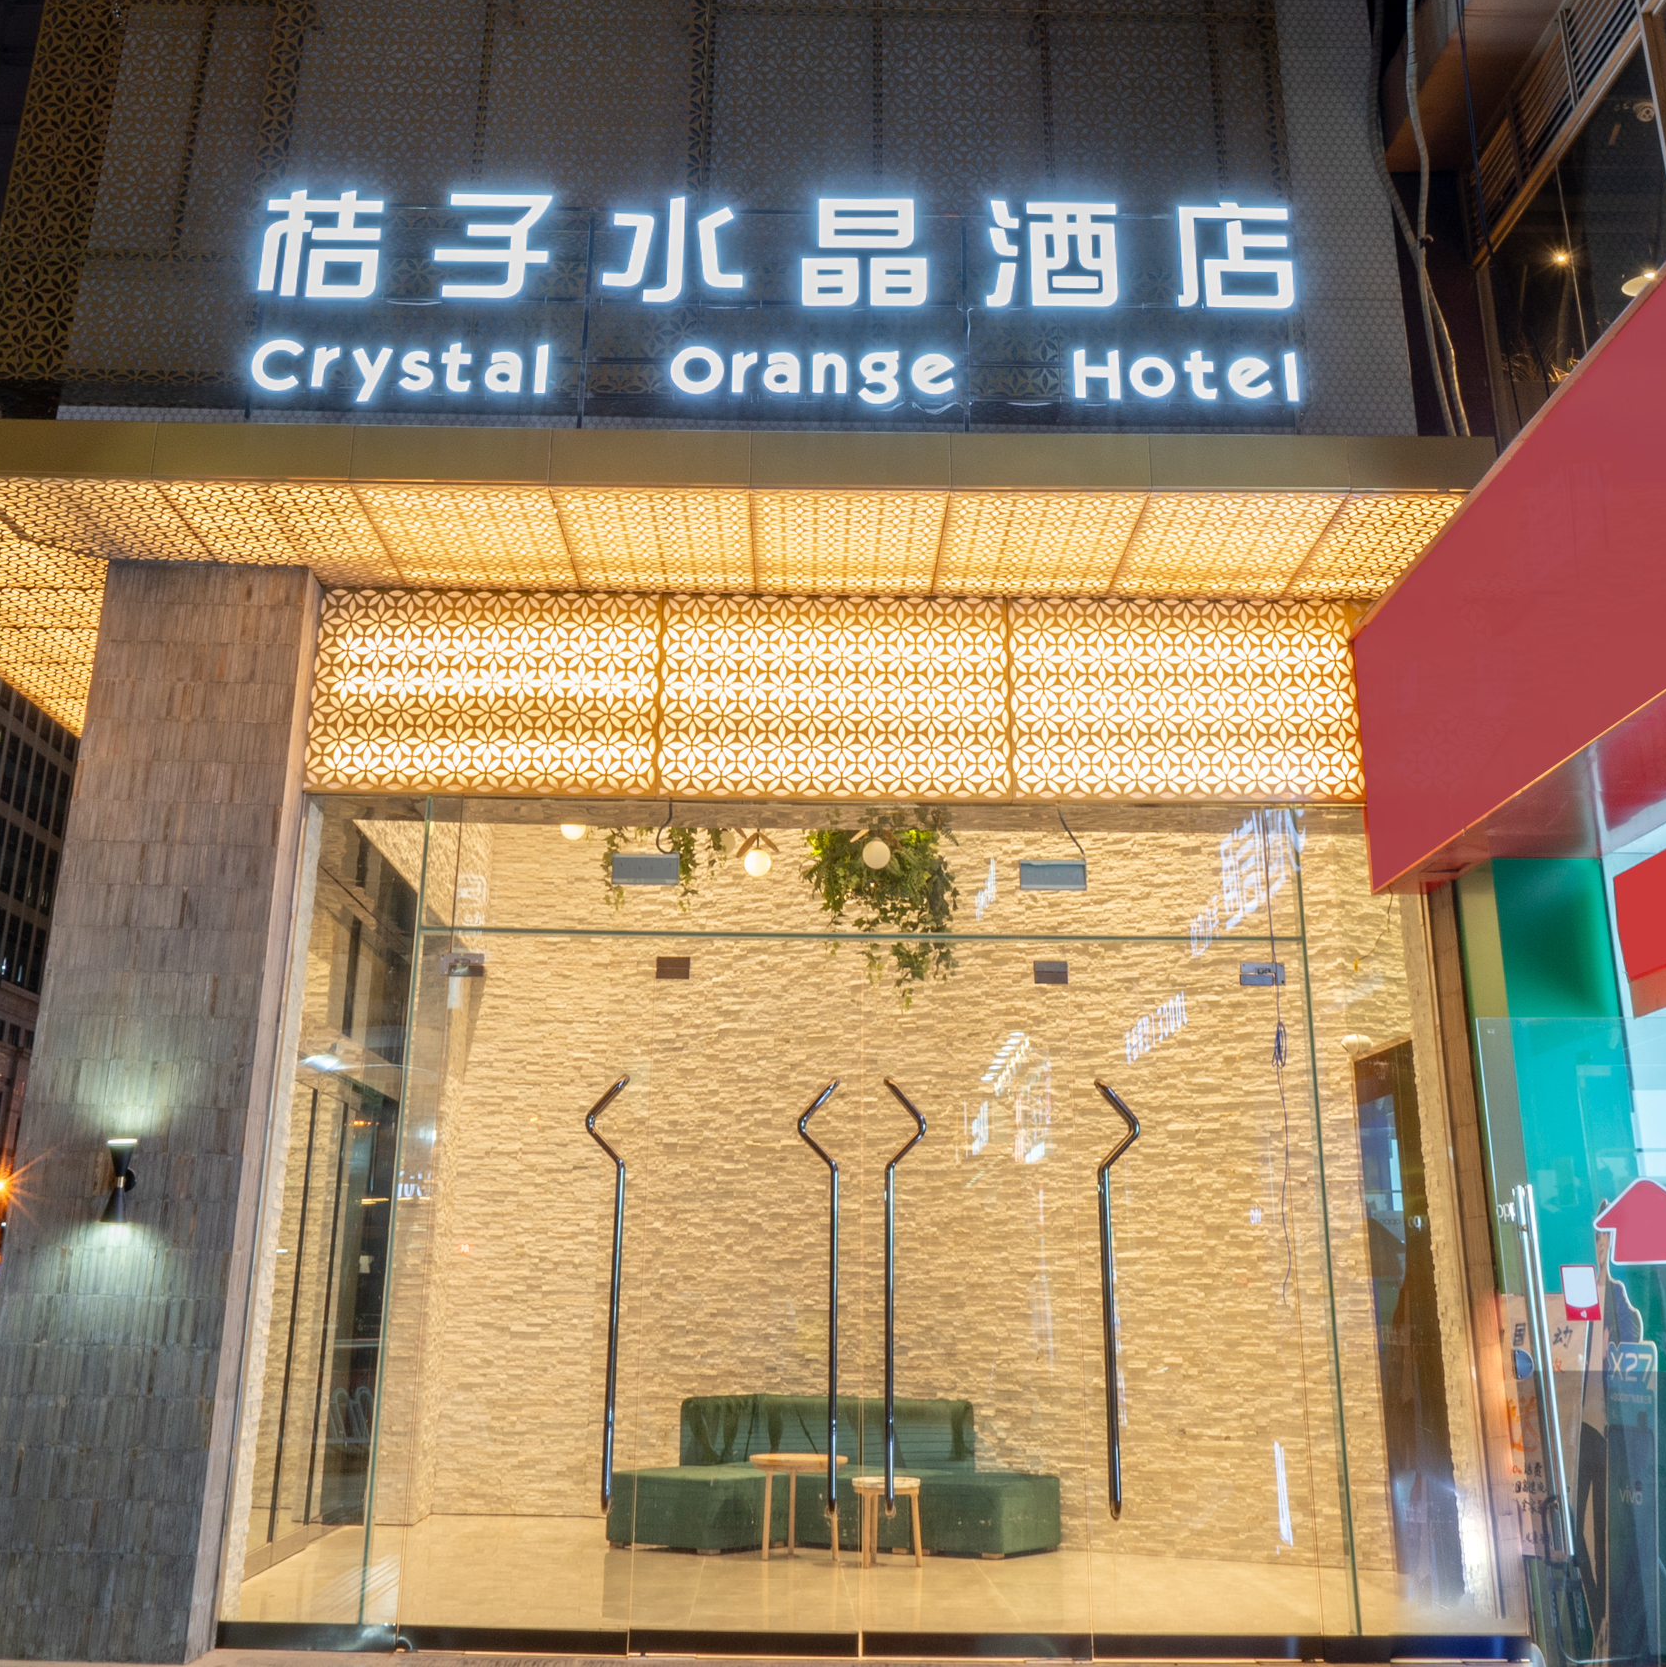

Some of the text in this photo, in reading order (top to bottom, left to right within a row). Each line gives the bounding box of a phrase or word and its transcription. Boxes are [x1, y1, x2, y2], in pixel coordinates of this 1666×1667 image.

[256, 189, 1295, 309] 桔子水晶酒店
[250, 339, 1302, 405] Crystal Orange Hotel
[1608, 1351, 1653, 1383] X27
[1619, 1484, 1643, 1506] vivo
